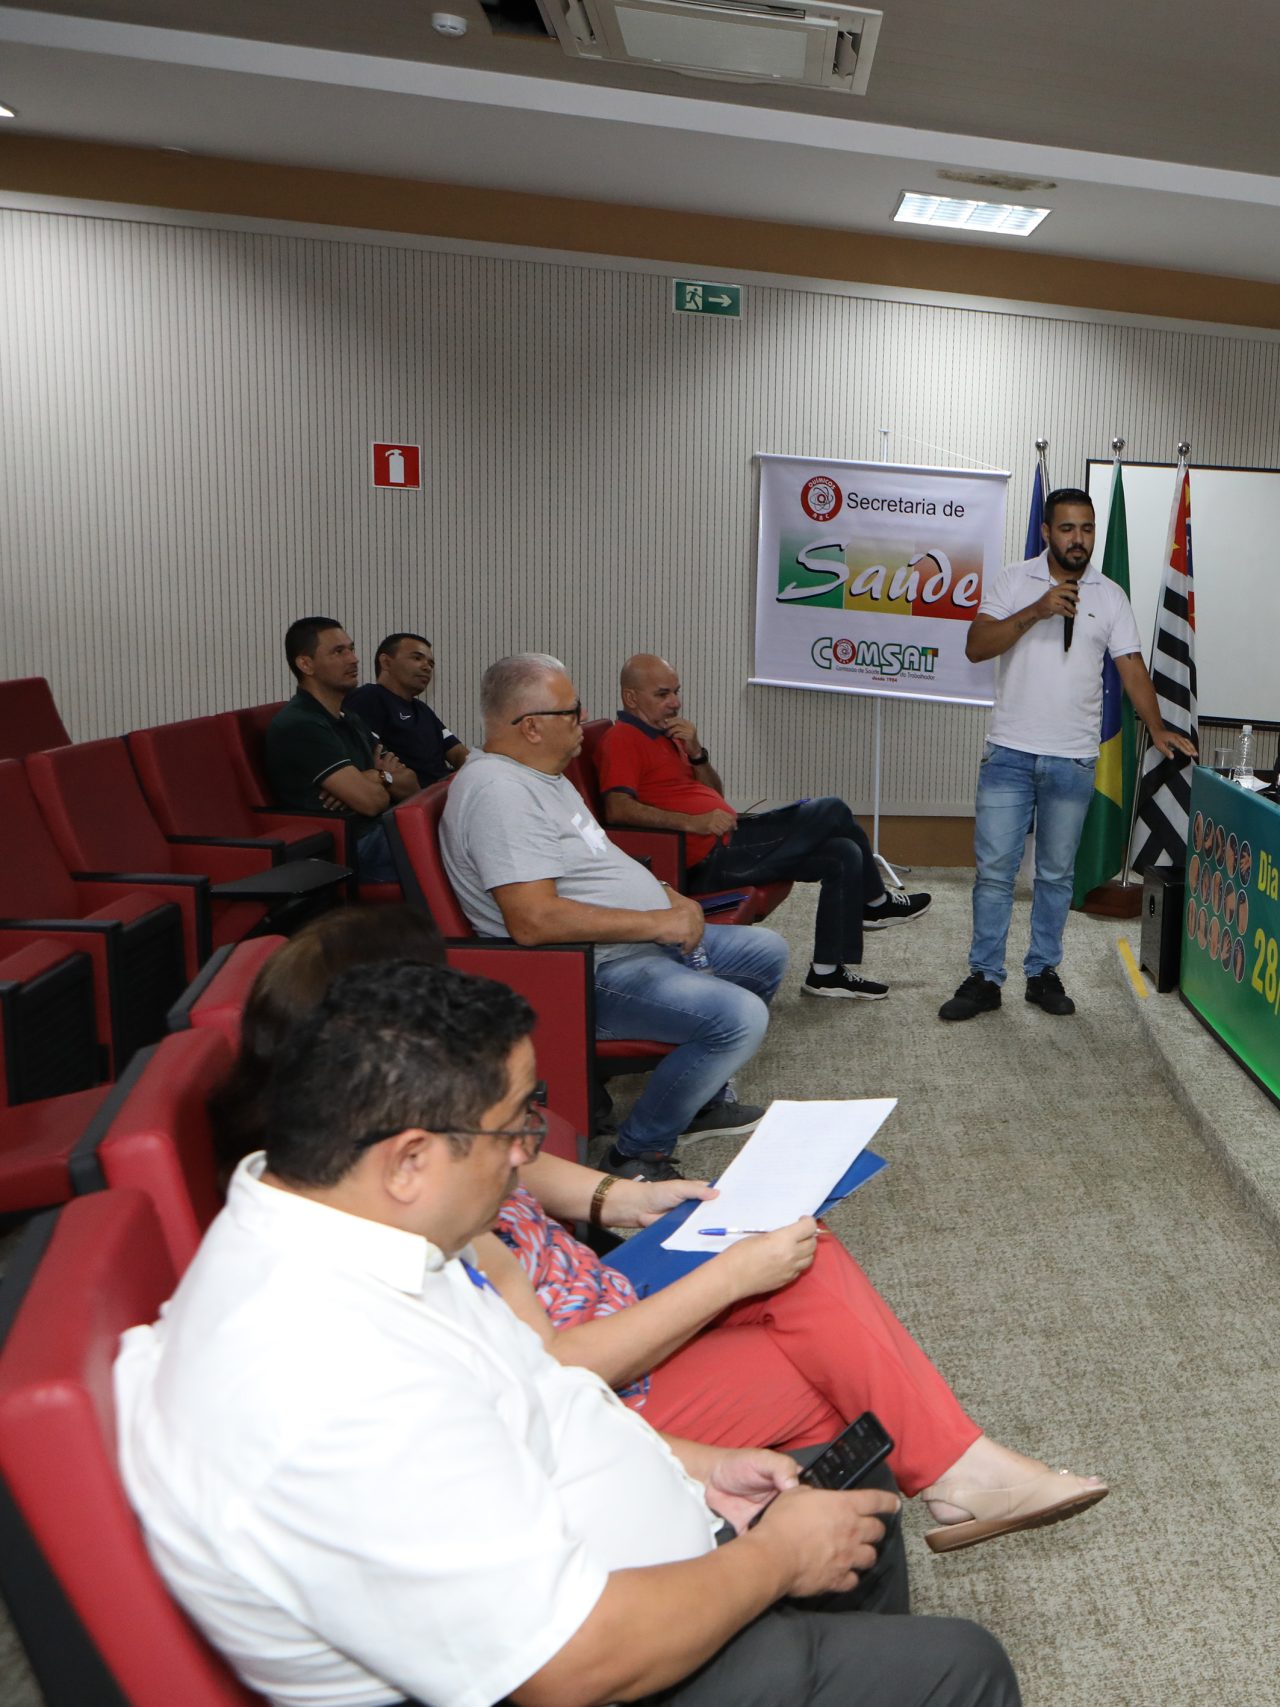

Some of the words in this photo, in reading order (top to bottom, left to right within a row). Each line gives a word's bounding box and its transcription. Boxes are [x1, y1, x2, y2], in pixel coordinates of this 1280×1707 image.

[808, 477, 836, 490] QUÍMICOS
[847, 492, 936, 516] Secretaria
[942, 501, 965, 518] de
[776, 536, 979, 608] Saúde
[811, 636, 939, 676] COMSAT
[1257, 850, 1279, 900] Dia
